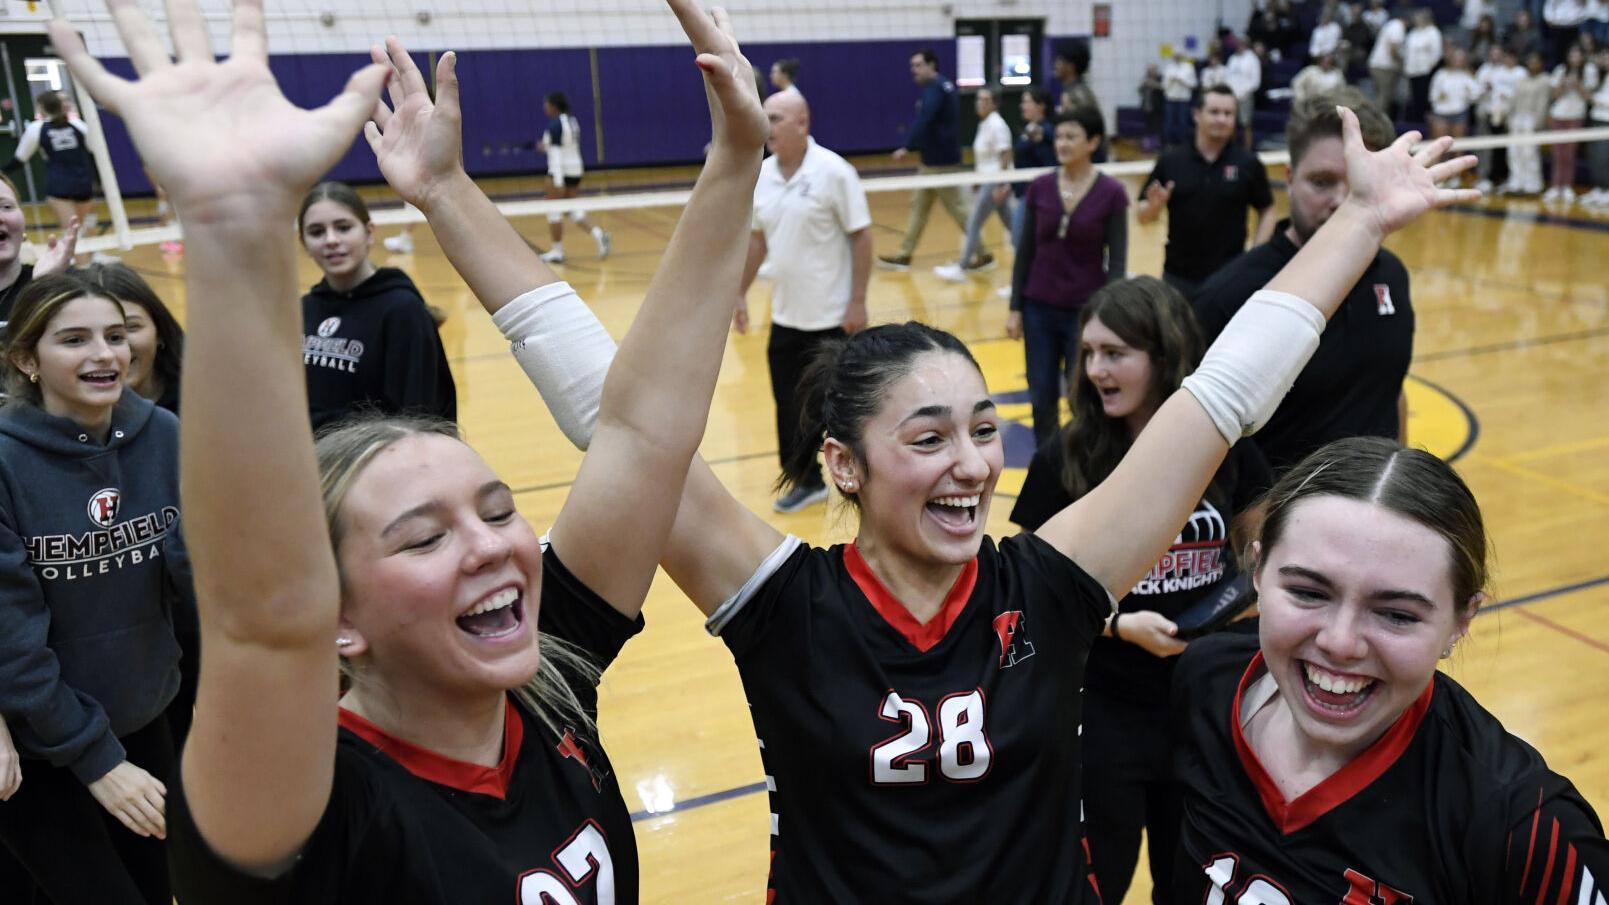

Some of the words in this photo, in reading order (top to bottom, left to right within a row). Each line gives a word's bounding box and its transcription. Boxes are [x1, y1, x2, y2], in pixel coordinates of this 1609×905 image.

[304, 352, 356, 373] EYBALL
[96, 495, 119, 523] H
[32, 541, 166, 580] OLLEYBA
[869, 687, 995, 787] 28
